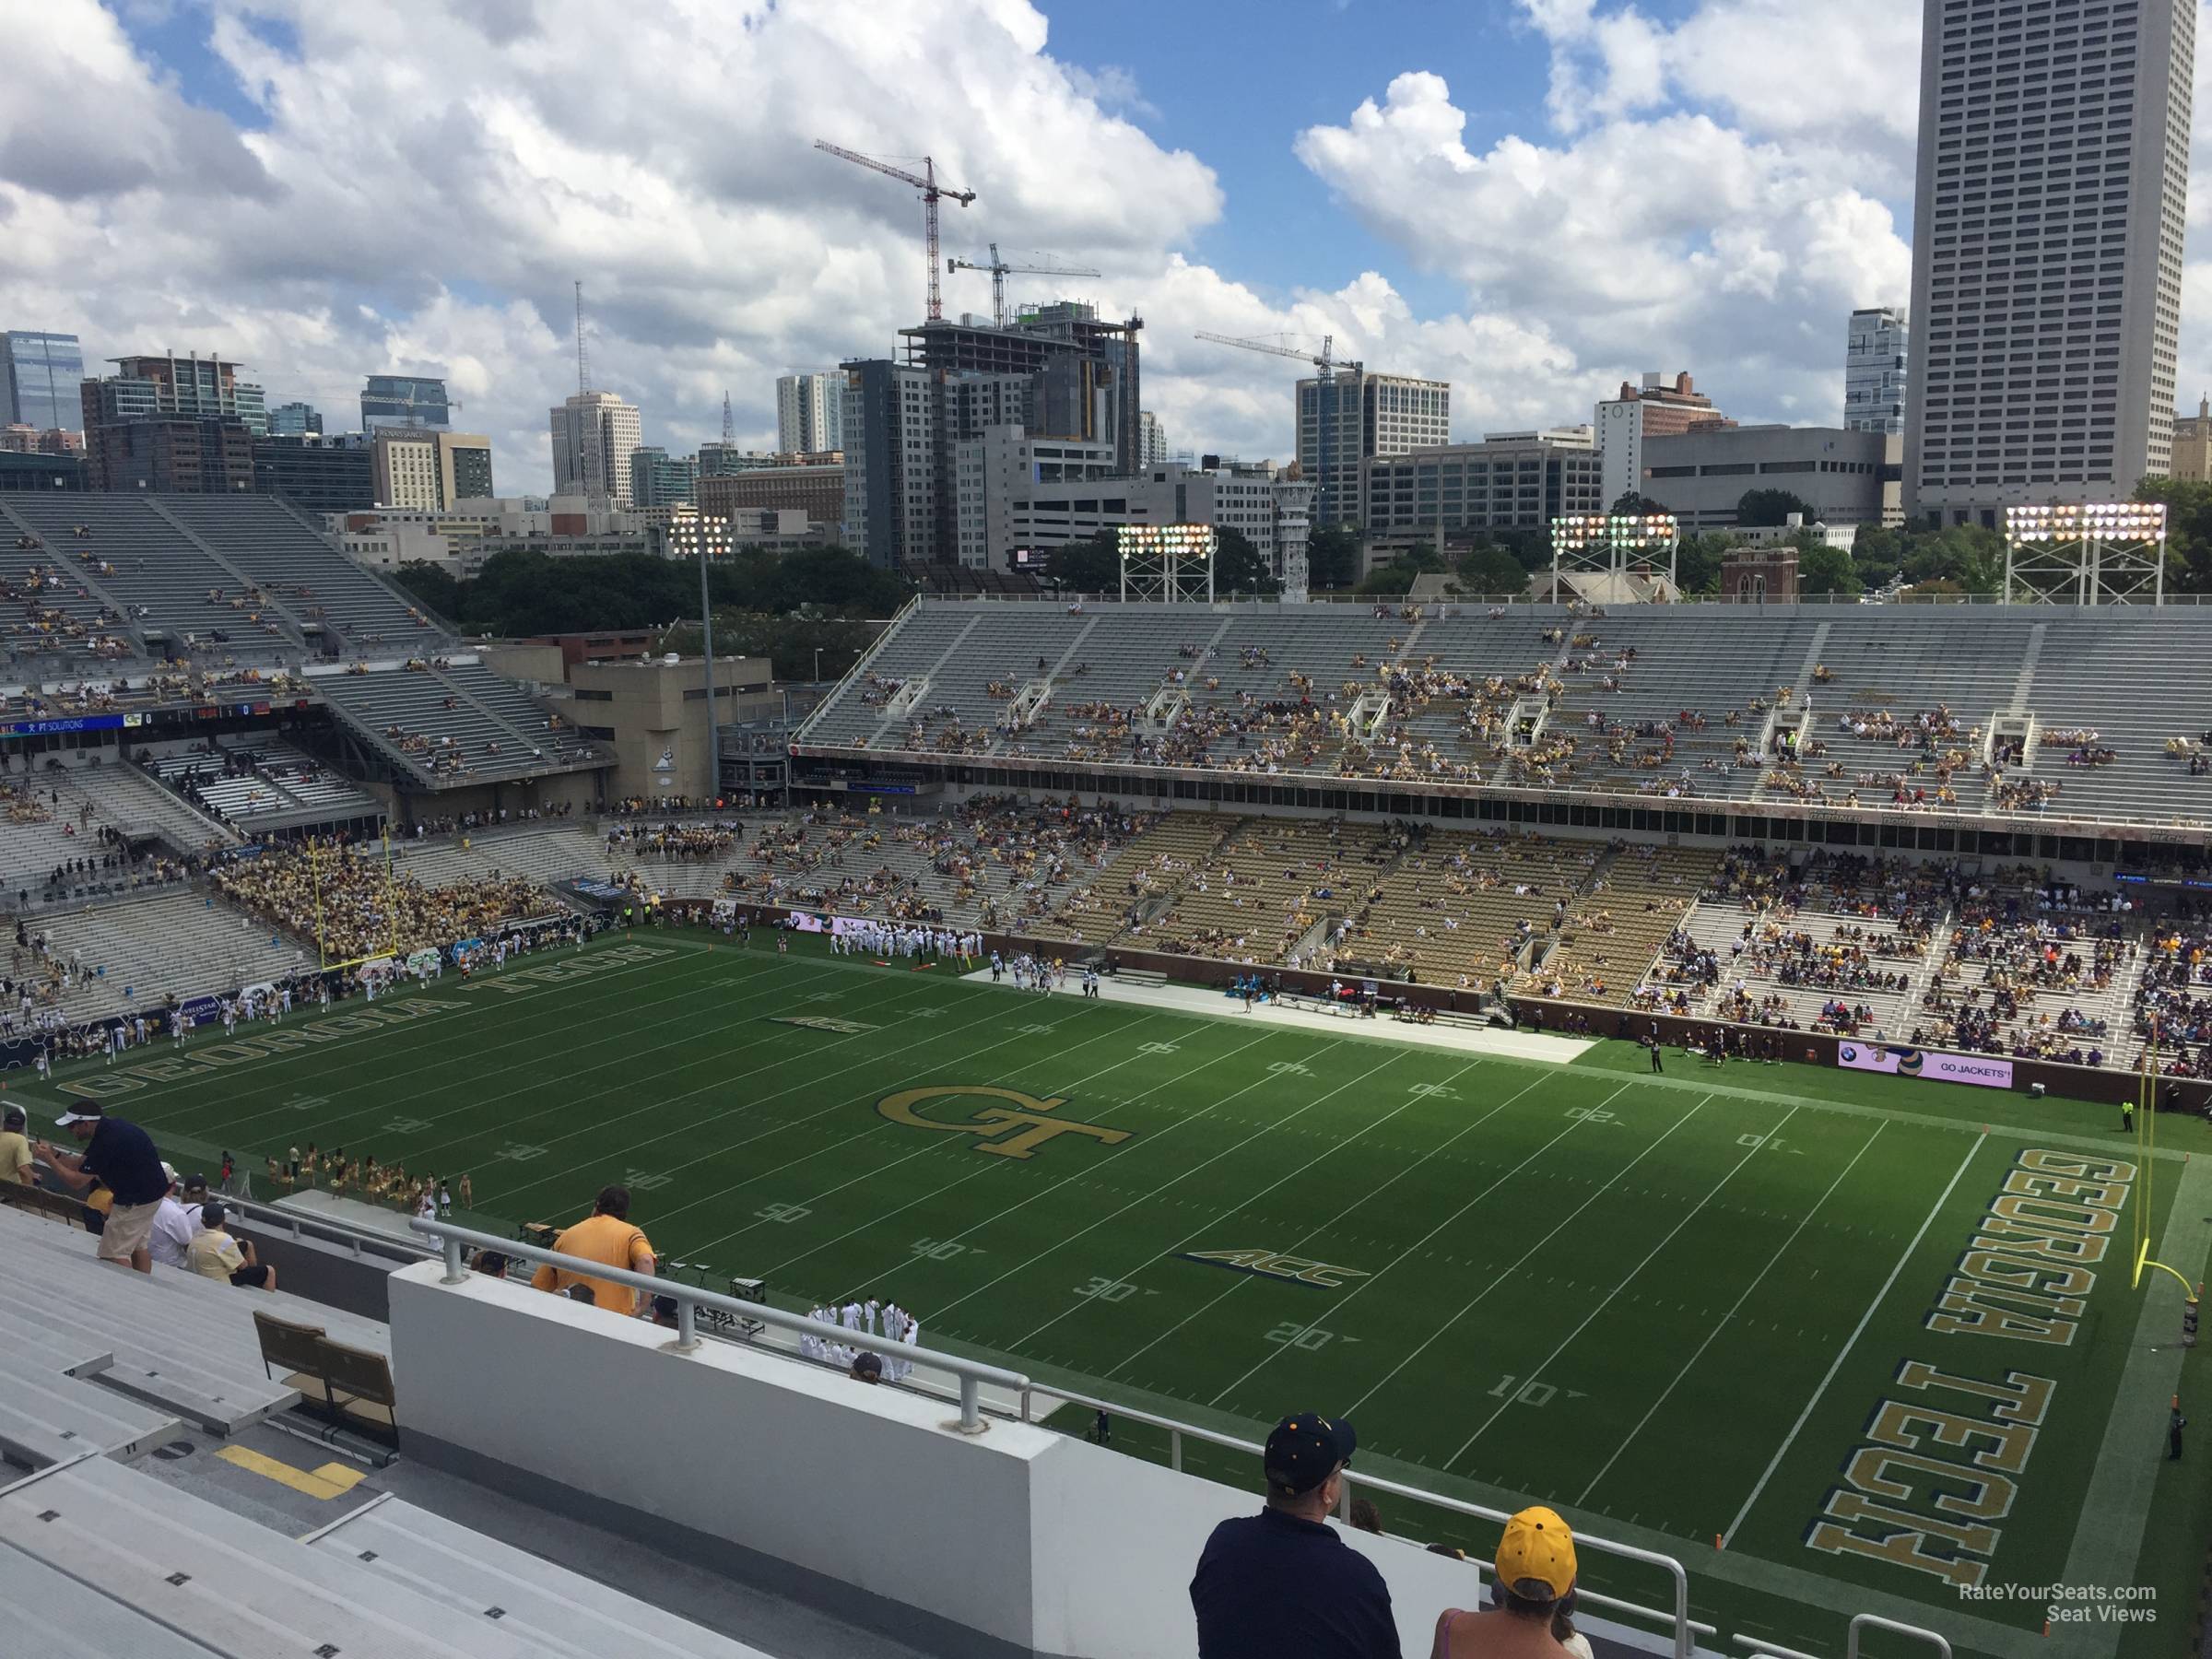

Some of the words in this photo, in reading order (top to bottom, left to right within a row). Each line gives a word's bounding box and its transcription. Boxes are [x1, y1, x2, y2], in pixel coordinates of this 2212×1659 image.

[146, 713, 152, 724] 0
[243, 704, 250, 715] 0
[1665, 803, 1726, 814] ALEXANDER
[457, 945, 677, 994] TECH
[55, 997, 472, 1099] GEORGIA
[1941, 1063, 1957, 1073] GO
[877, 1085, 1136, 1160] GT
[1564, 1107, 1616, 1123] 20
[1735, 1133, 1786, 1151] 10
[753, 1202, 813, 1223] 50
[910, 1237, 967, 1261] 40
[1925, 1148, 2137, 1347] GEORGIA
[1186, 1249, 1371, 1288] ACC
[1072, 1276, 1138, 1303] 30
[1263, 1321, 1335, 1351] 20
[1487, 1374, 1559, 1407] 10
[1805, 1359, 2057, 1591] TECH
